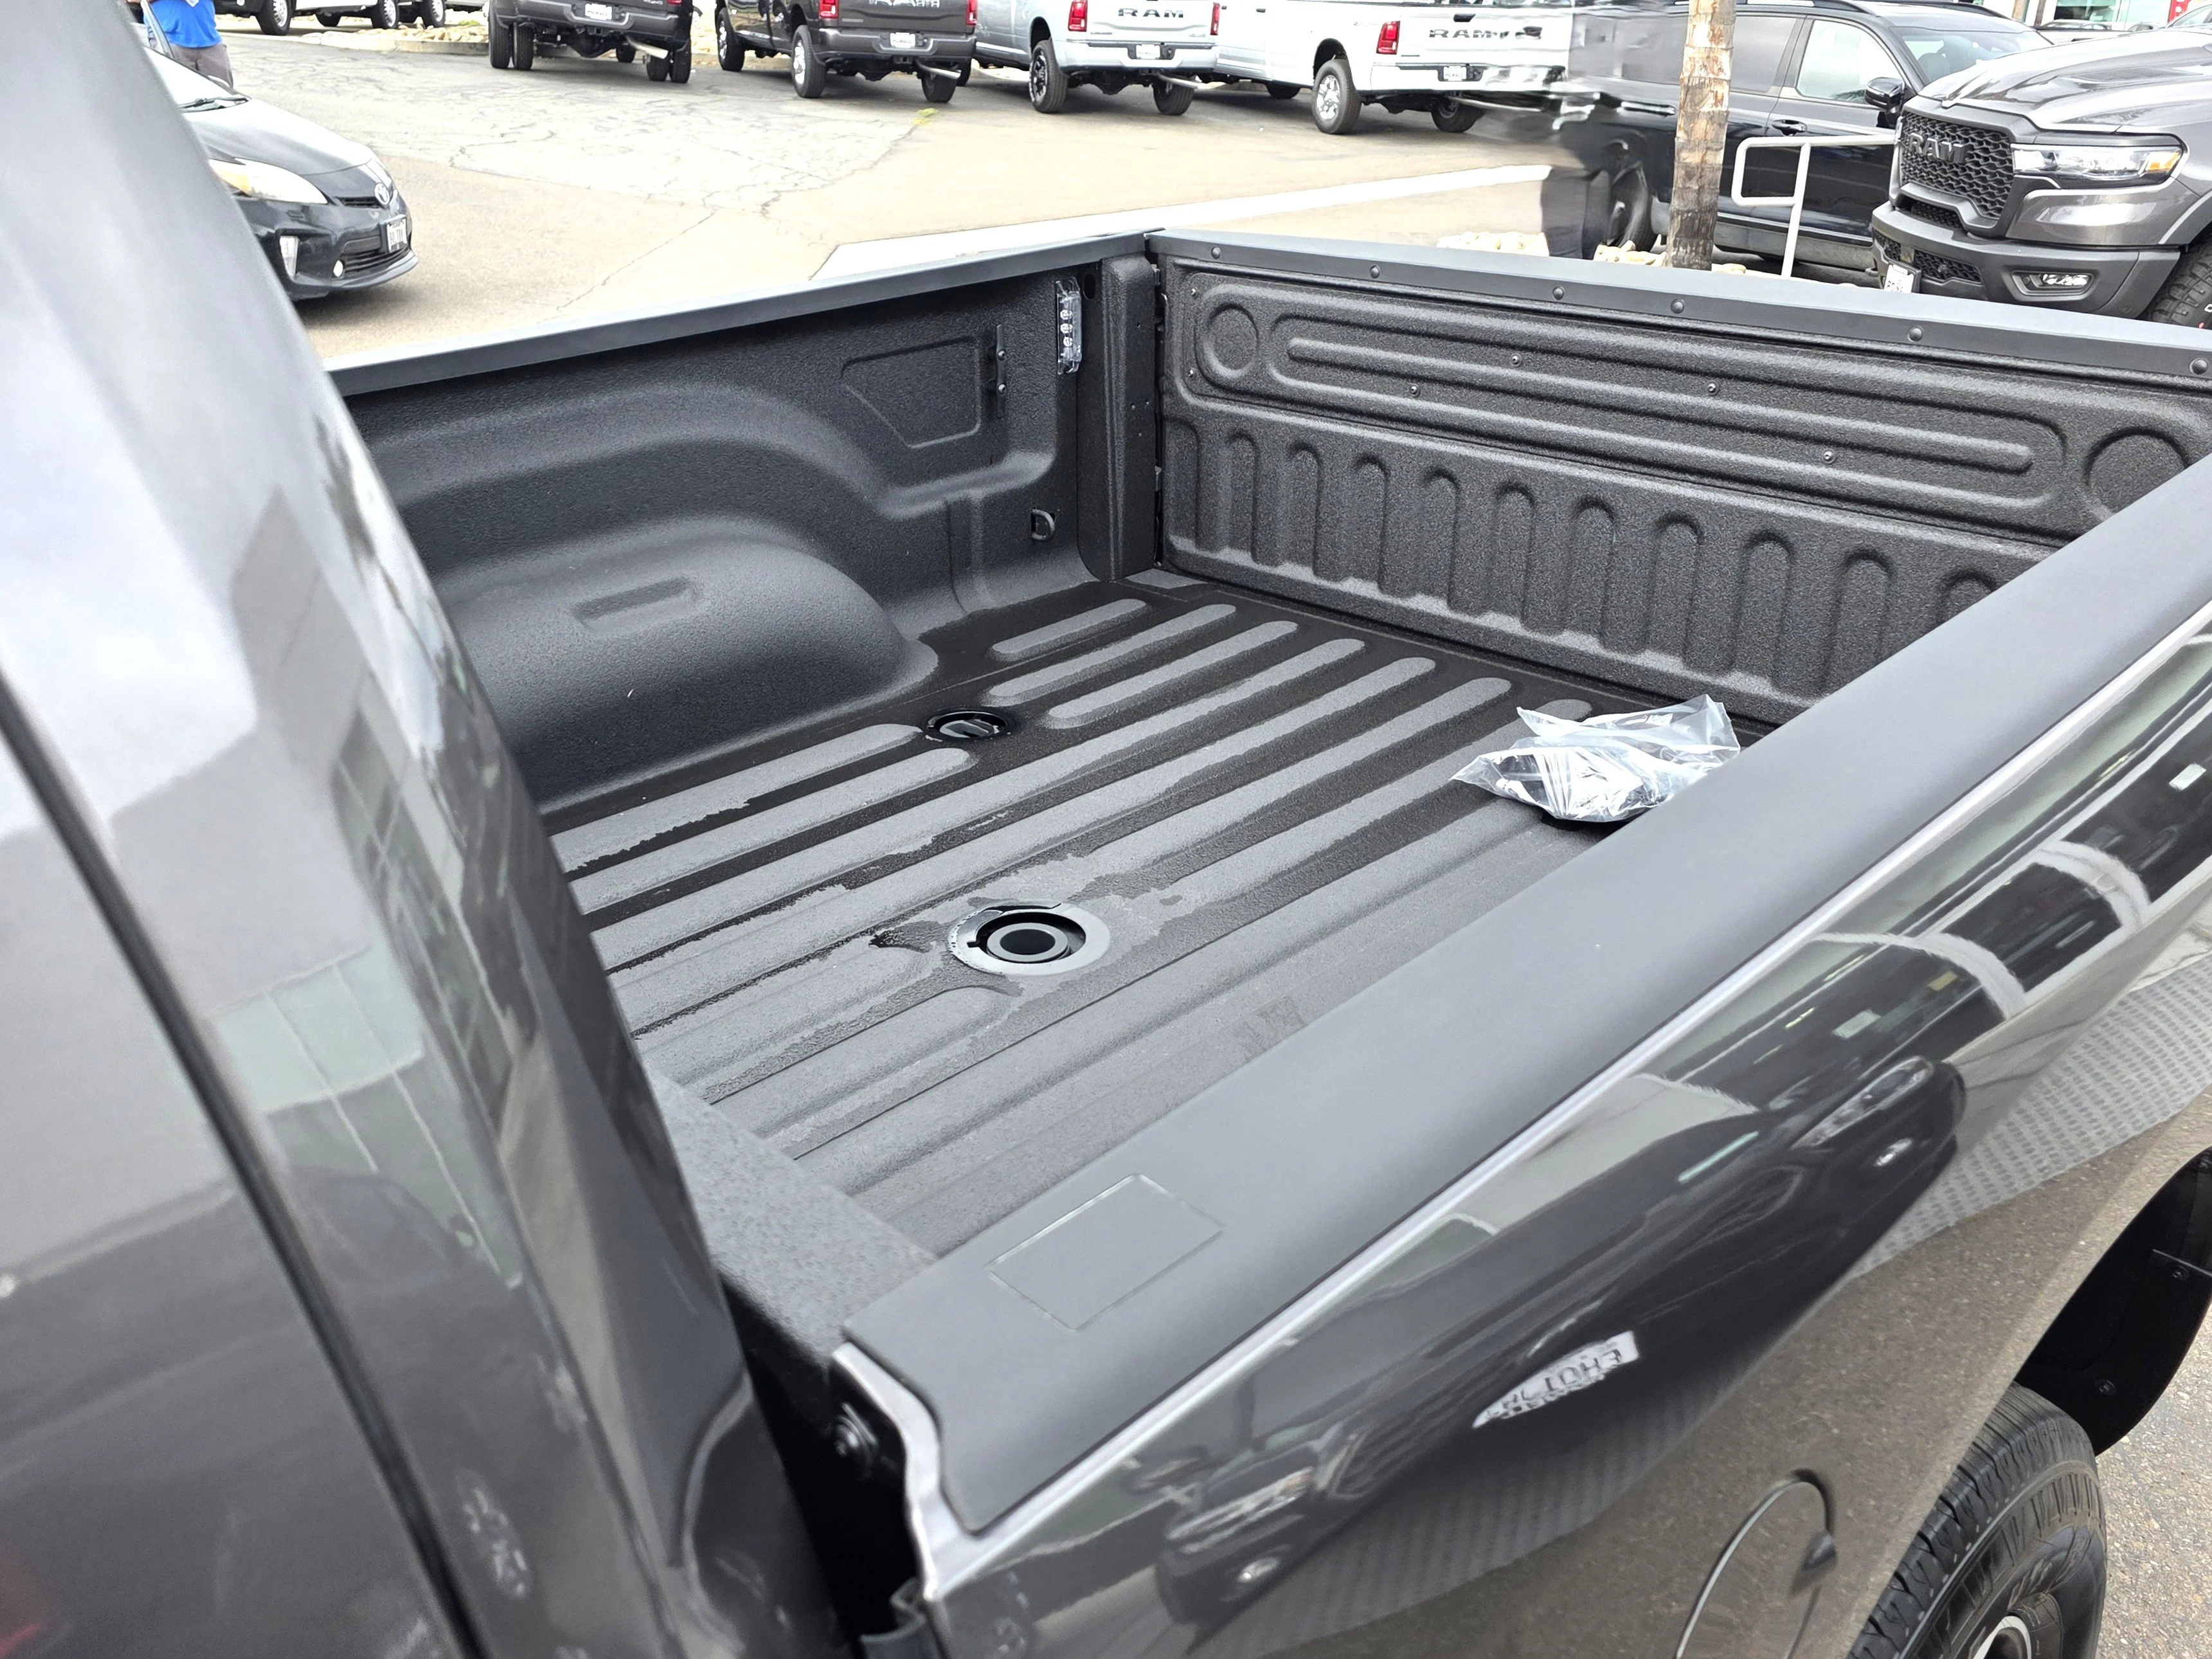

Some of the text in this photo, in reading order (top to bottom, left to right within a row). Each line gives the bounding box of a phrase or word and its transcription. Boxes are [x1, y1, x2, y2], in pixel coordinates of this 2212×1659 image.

[1118, 8, 1183, 18] RAM
[1429, 29, 1491, 39] RAM
[1908, 132, 1965, 163] RAM
